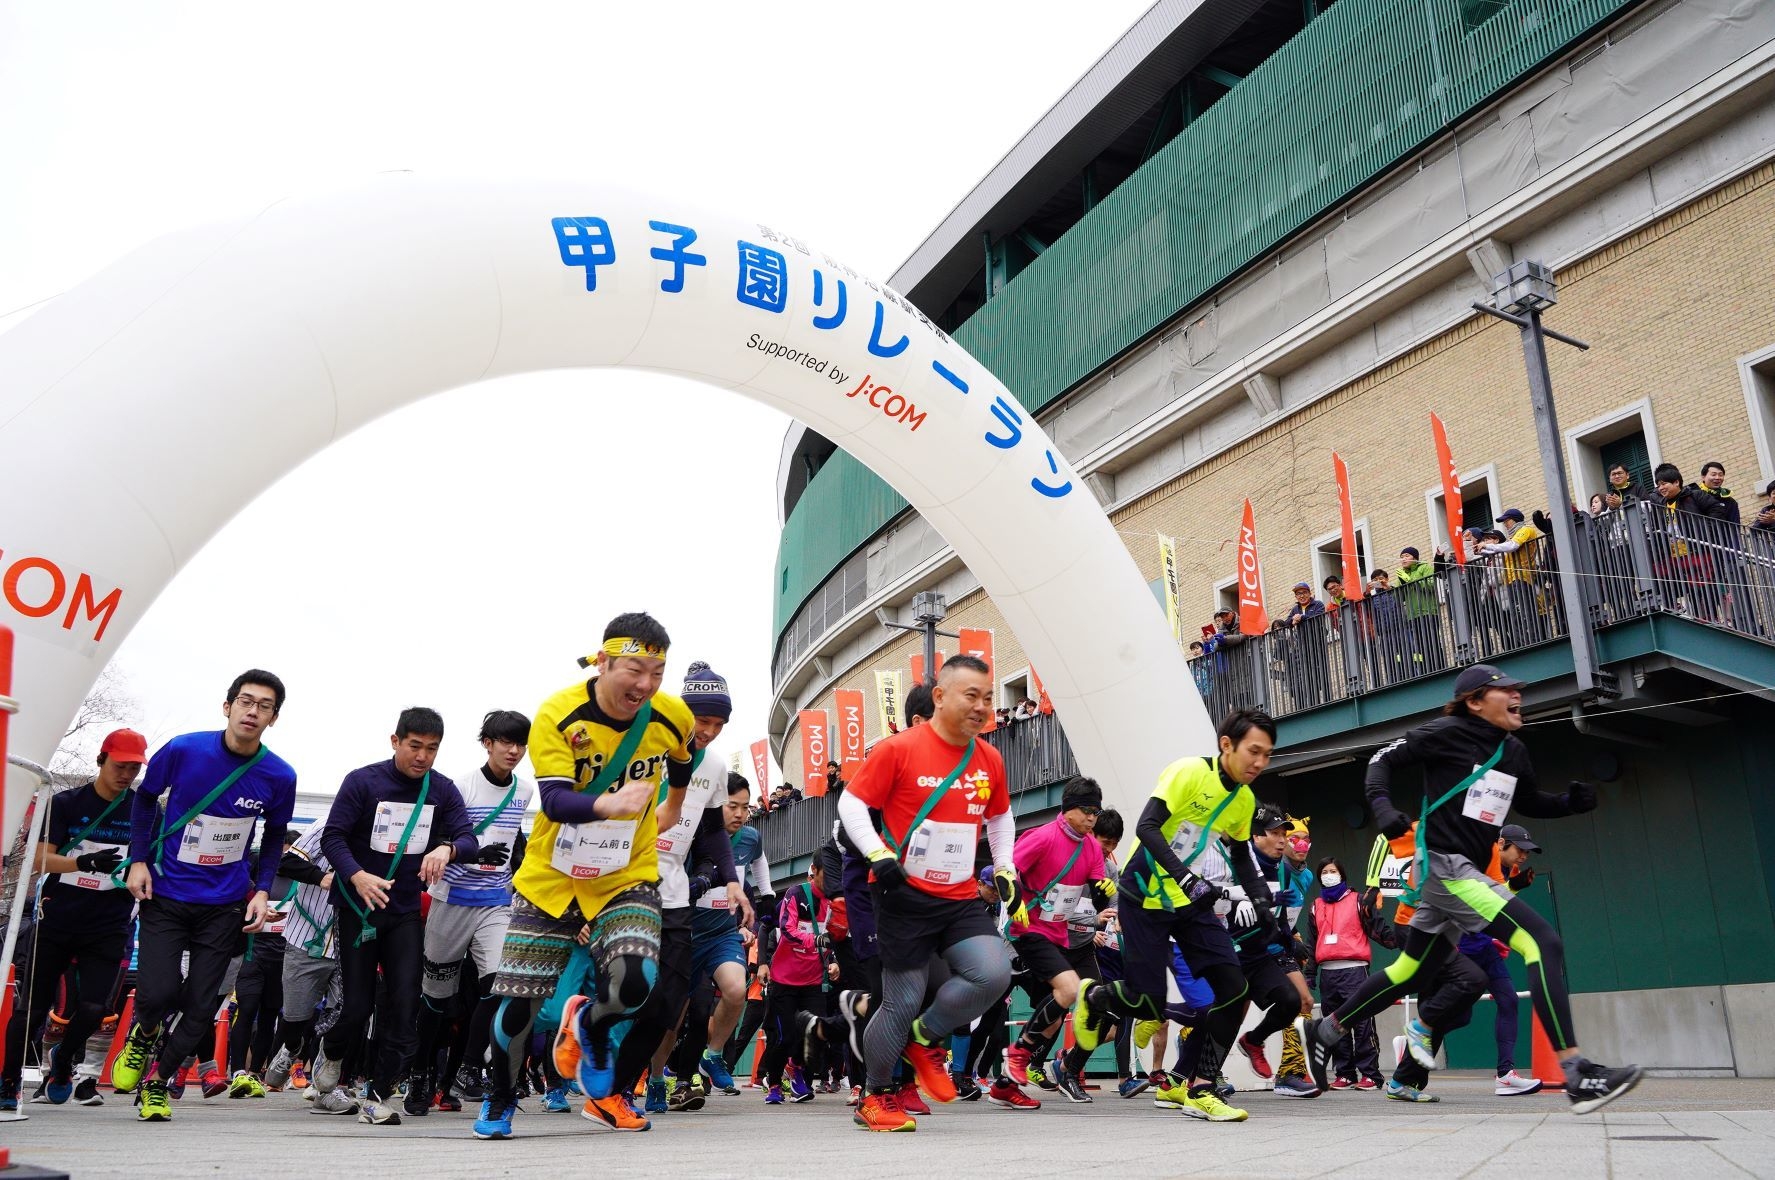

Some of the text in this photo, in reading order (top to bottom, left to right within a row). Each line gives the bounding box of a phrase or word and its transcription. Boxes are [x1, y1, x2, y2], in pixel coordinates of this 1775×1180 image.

[746, 333, 927, 432] Supported by J:COM
[579, 836, 630, 850] ドーム前 B
[574, 867, 599, 876] J:COM
